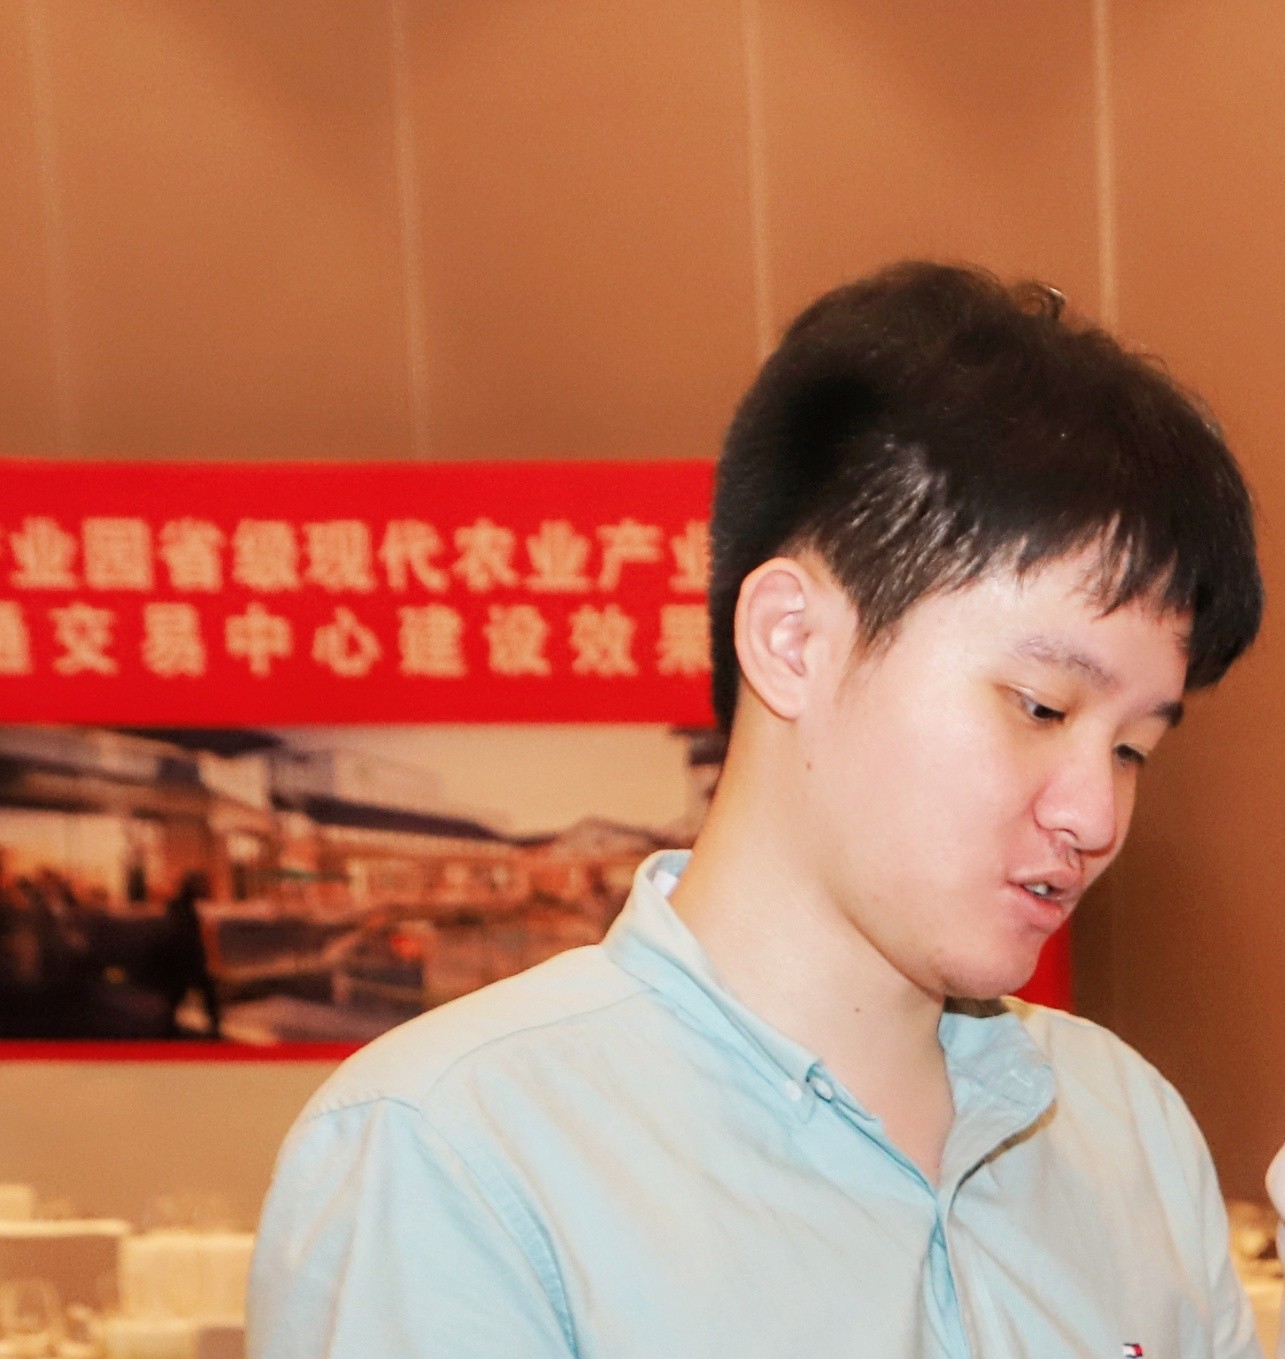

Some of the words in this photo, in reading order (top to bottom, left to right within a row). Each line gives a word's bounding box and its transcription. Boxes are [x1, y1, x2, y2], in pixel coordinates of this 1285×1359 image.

[0, 516, 711, 591] 业园省级现代农业产业
